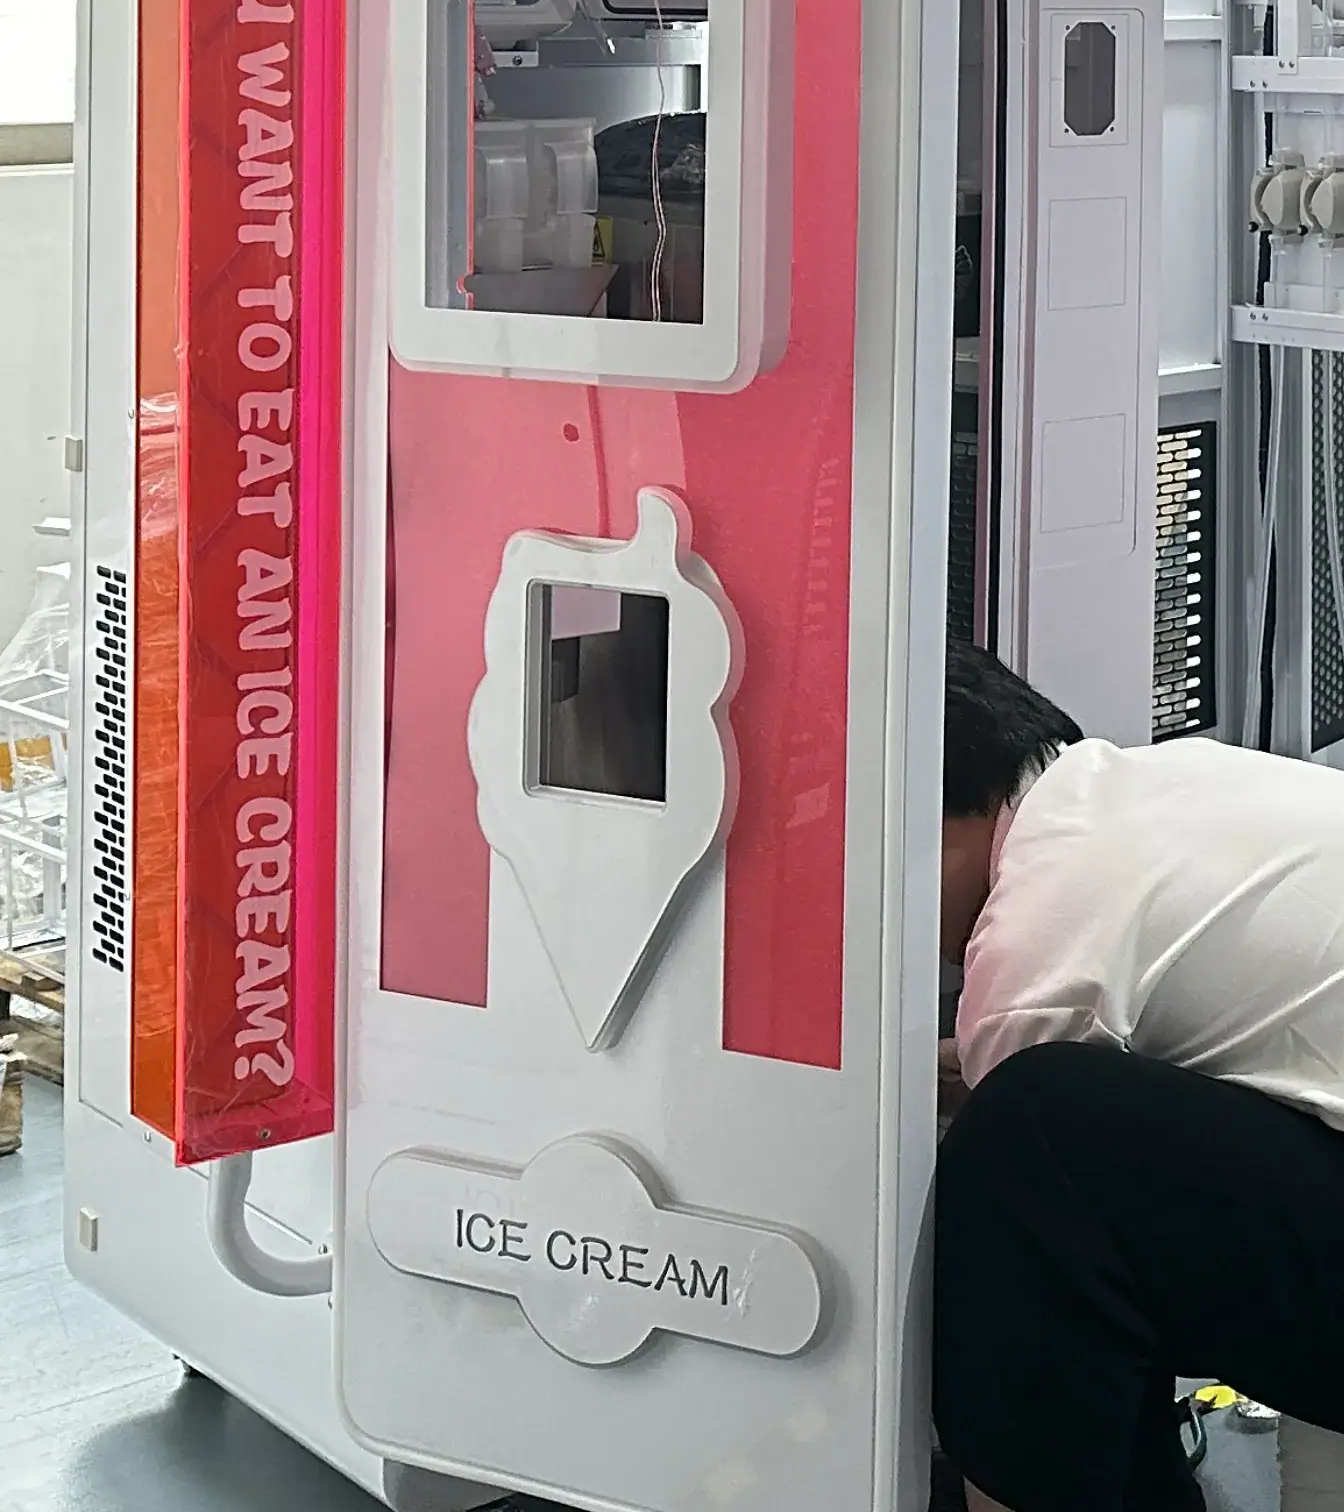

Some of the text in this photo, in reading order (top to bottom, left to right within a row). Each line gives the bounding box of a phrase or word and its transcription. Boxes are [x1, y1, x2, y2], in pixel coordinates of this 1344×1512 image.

[237, 41, 296, 259] WANT
[237, 274, 294, 372] TO
[237, 388, 296, 529] EAT
[236, 548, 294, 651] AN
[236, 665, 294, 779] ICE
[234, 797, 295, 1086] CREAM?
[456, 1207, 730, 1307] ICE CREAM
